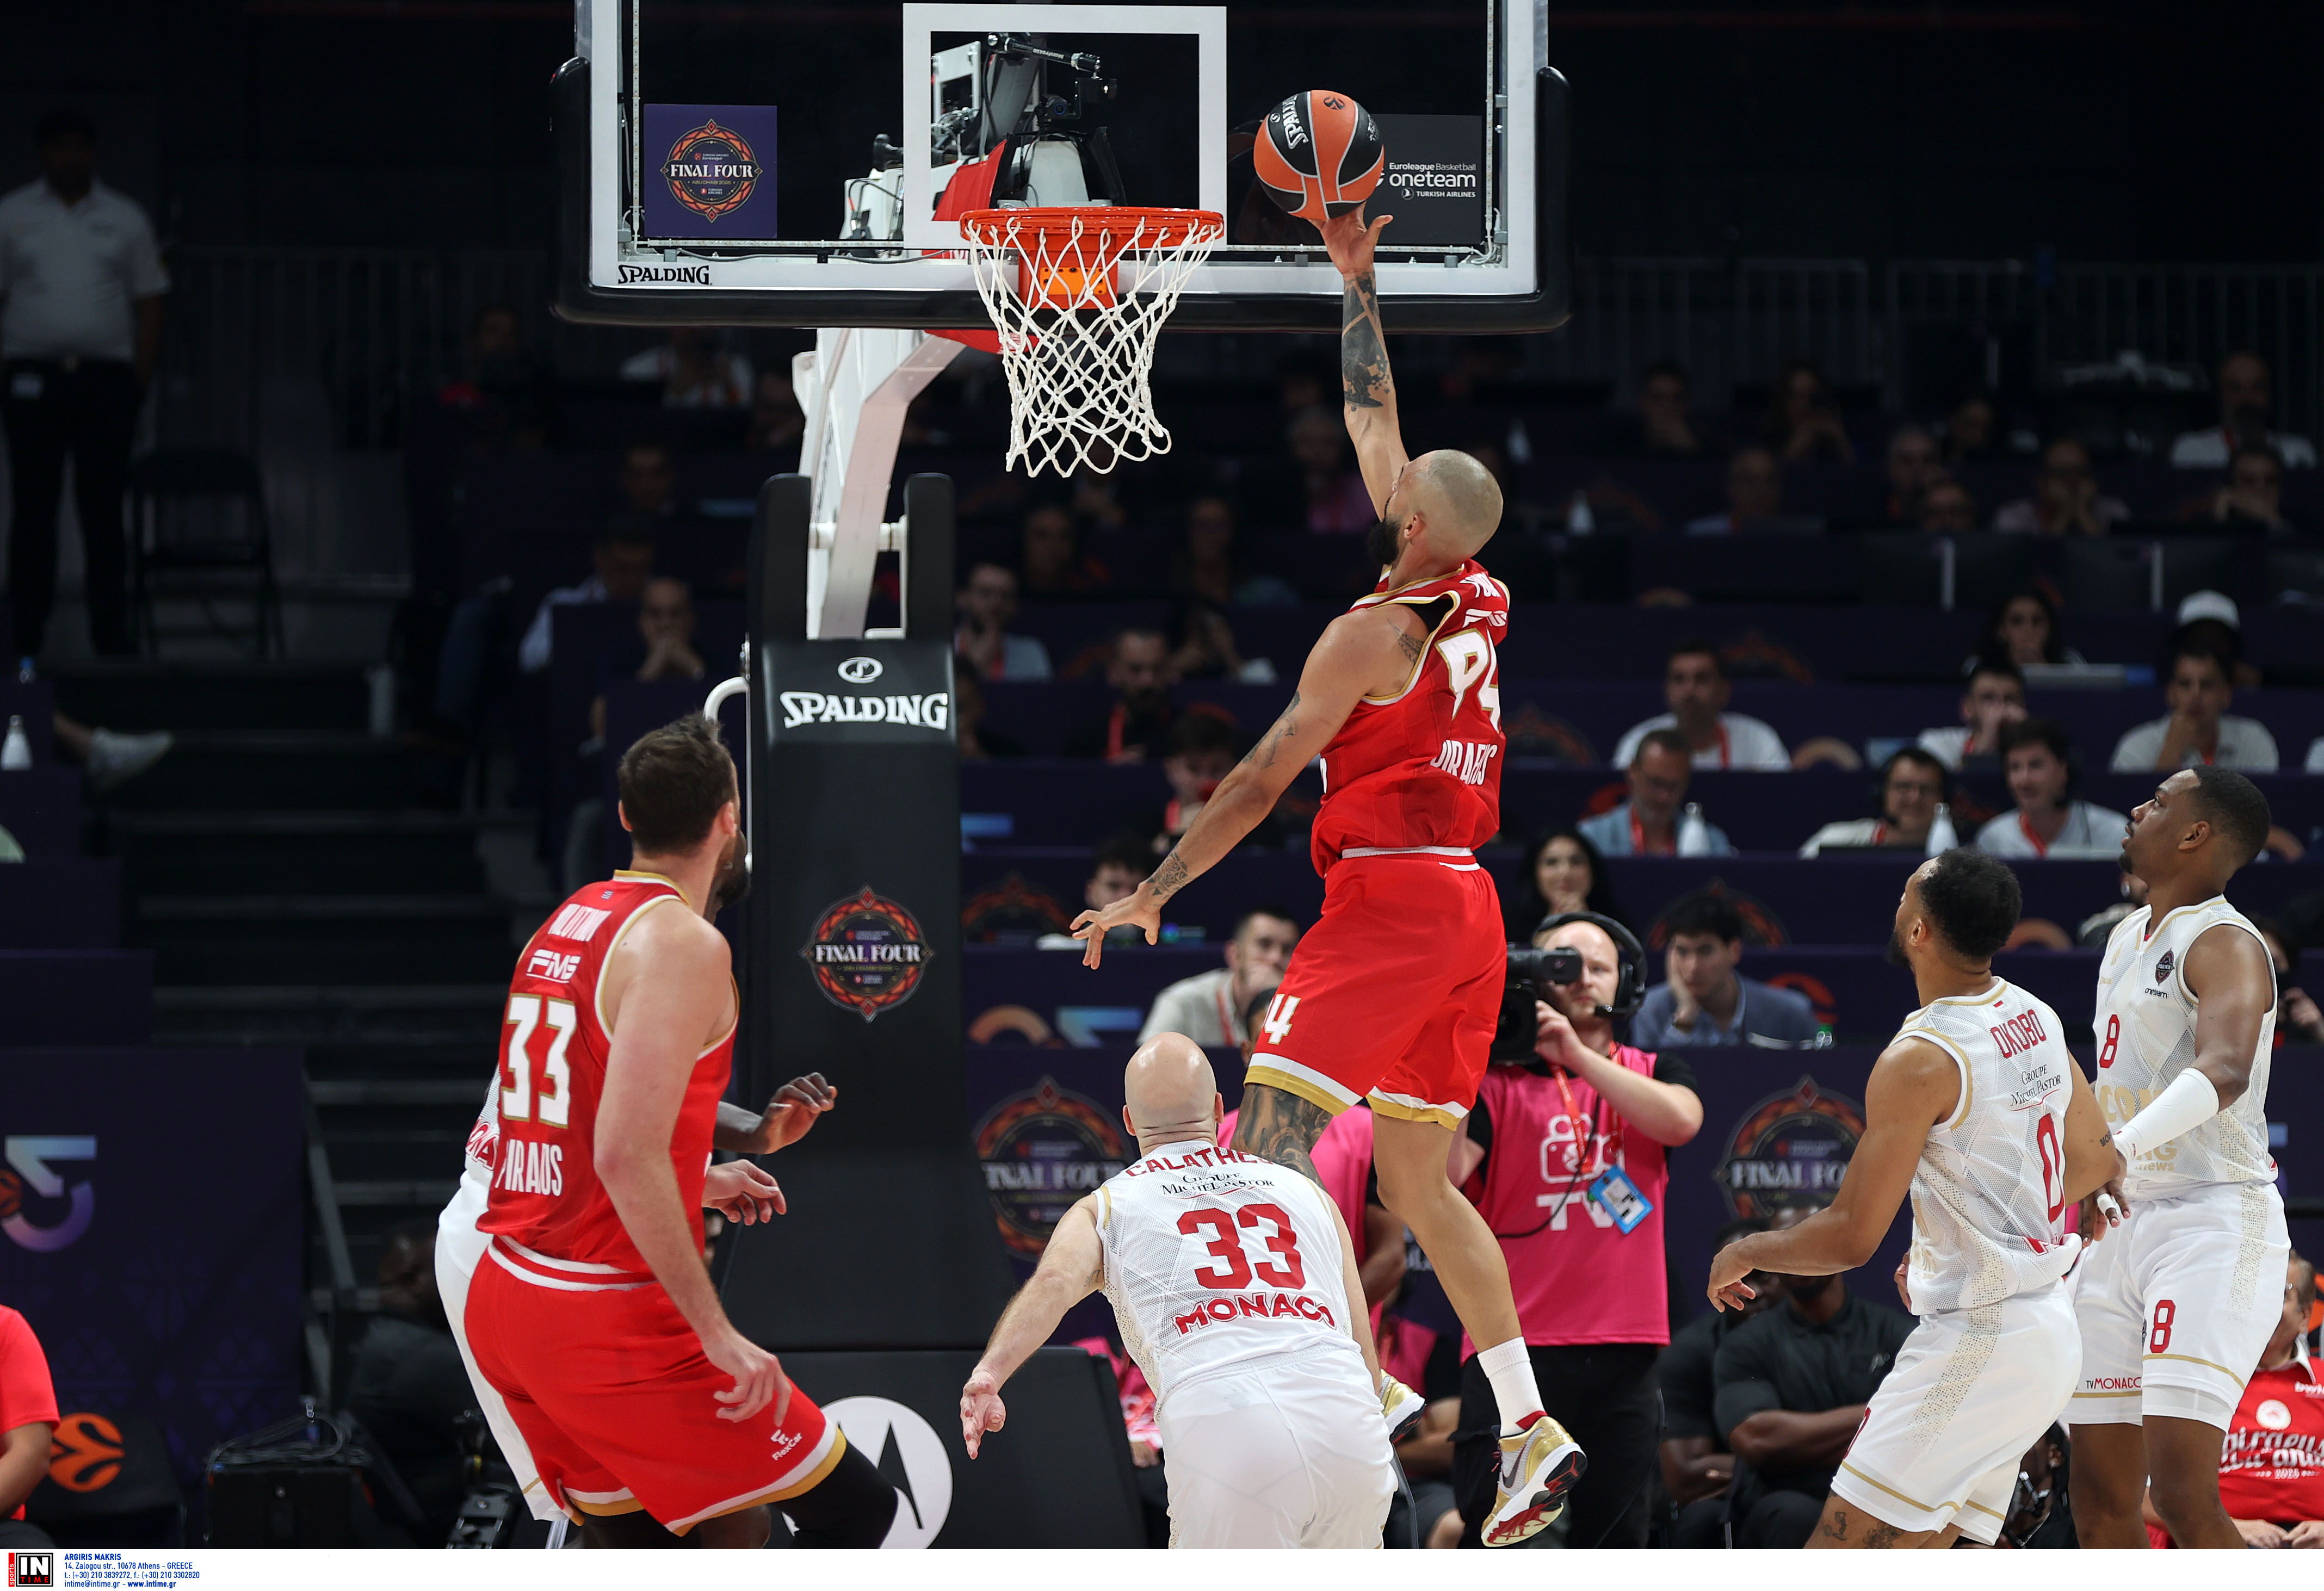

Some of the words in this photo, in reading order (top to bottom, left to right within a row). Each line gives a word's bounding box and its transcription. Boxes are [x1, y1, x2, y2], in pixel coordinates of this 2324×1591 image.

[670, 164, 712, 177] FINAL
[714, 164, 753, 178] FOUR
[1389, 162, 1435, 172] Euroleague
[1389, 171, 1476, 188] oneteam
[618, 264, 710, 285] SPALDING
[780, 691, 948, 730] SPALDING
[815, 944, 869, 962] FINAL
[871, 944, 921, 962] FOUR
[1263, 994, 1301, 1045] 4
[1990, 1009, 2047, 1058] OKOBO
[2099, 1014, 2120, 1068] 8
[499, 993, 577, 1129] 33
[2021, 1064, 2048, 1085] GROUPE
[2010, 1088, 2037, 1107] MICHEL
[2036, 1074, 2061, 1094] PASTOR
[494, 1139, 563, 1196] IRAUS
[981, 1161, 1044, 1190] INAL
[1176, 1203, 1306, 1290] 33
[1172, 1292, 1337, 1337] MONACO
[2149, 1299, 2176, 1353] 8
[771, 1432, 802, 1461] FlexCar
